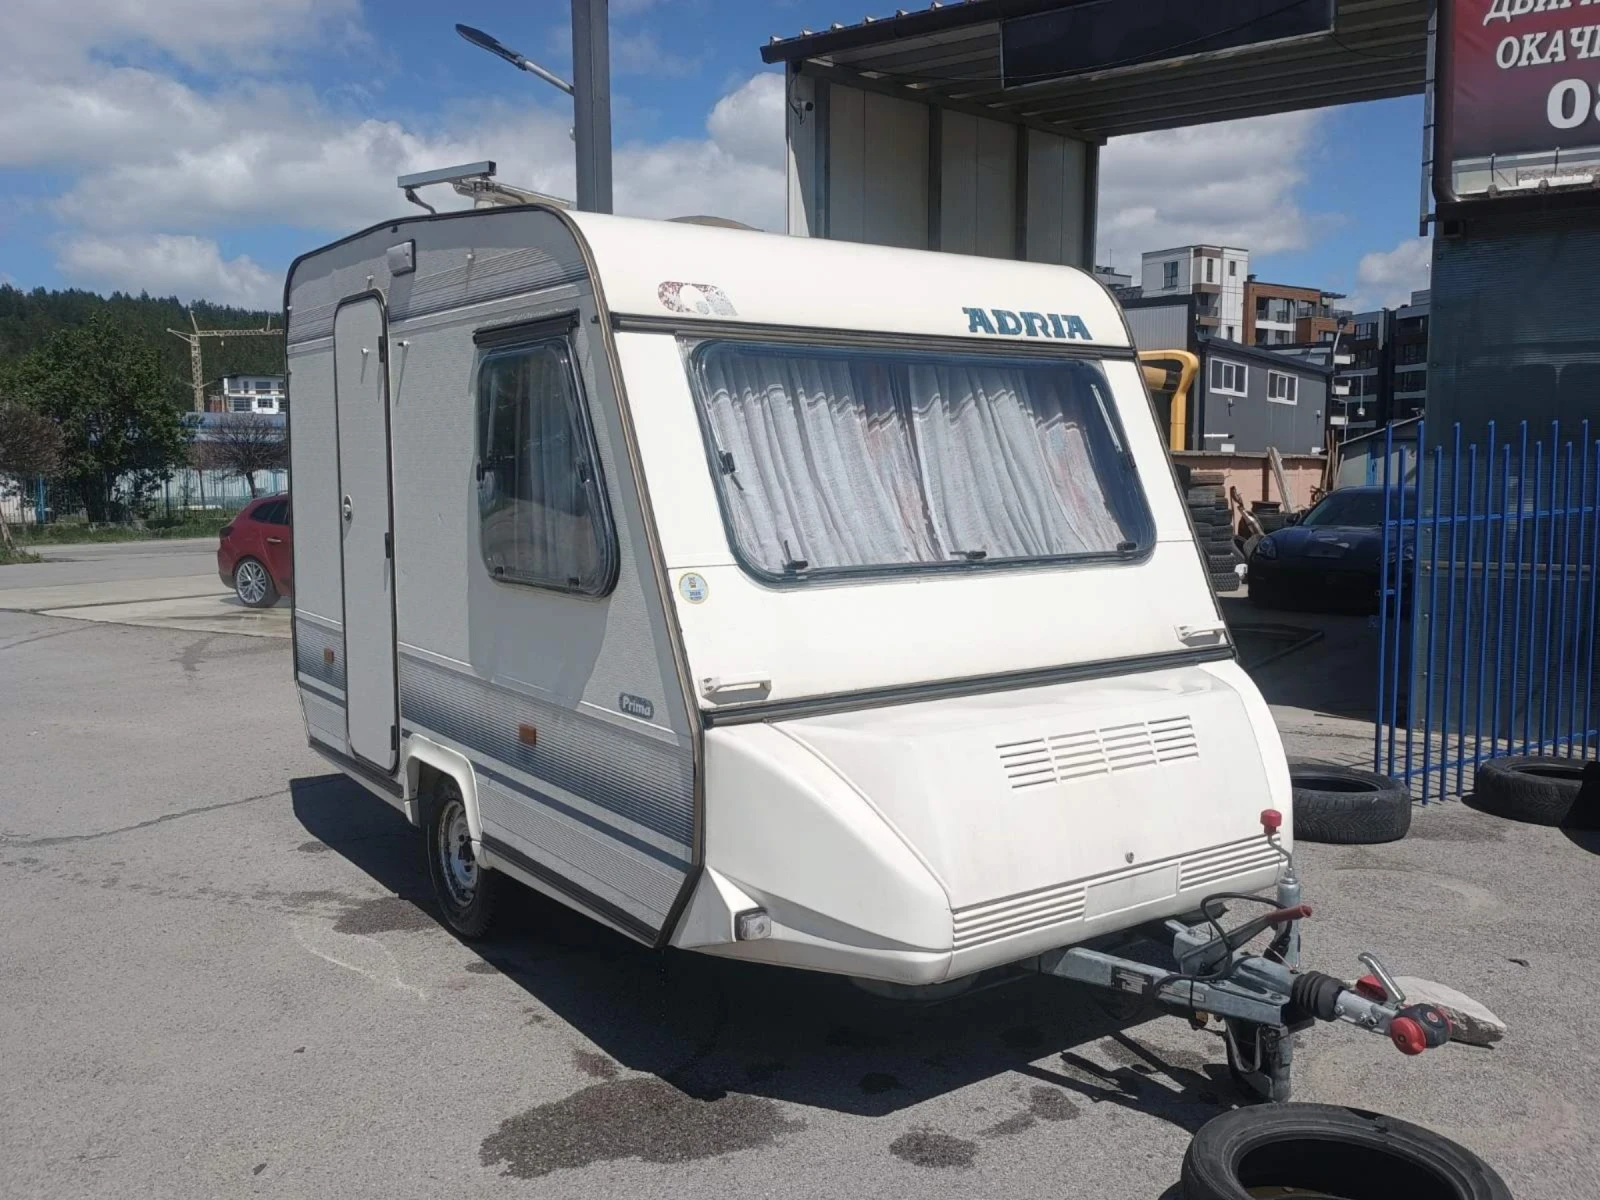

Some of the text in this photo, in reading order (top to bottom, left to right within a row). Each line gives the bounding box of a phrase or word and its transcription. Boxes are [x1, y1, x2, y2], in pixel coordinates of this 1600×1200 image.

[1547, 78, 1600, 129] 0
[962, 307, 1093, 340] ADRIA
[622, 695, 651, 717] Prima
